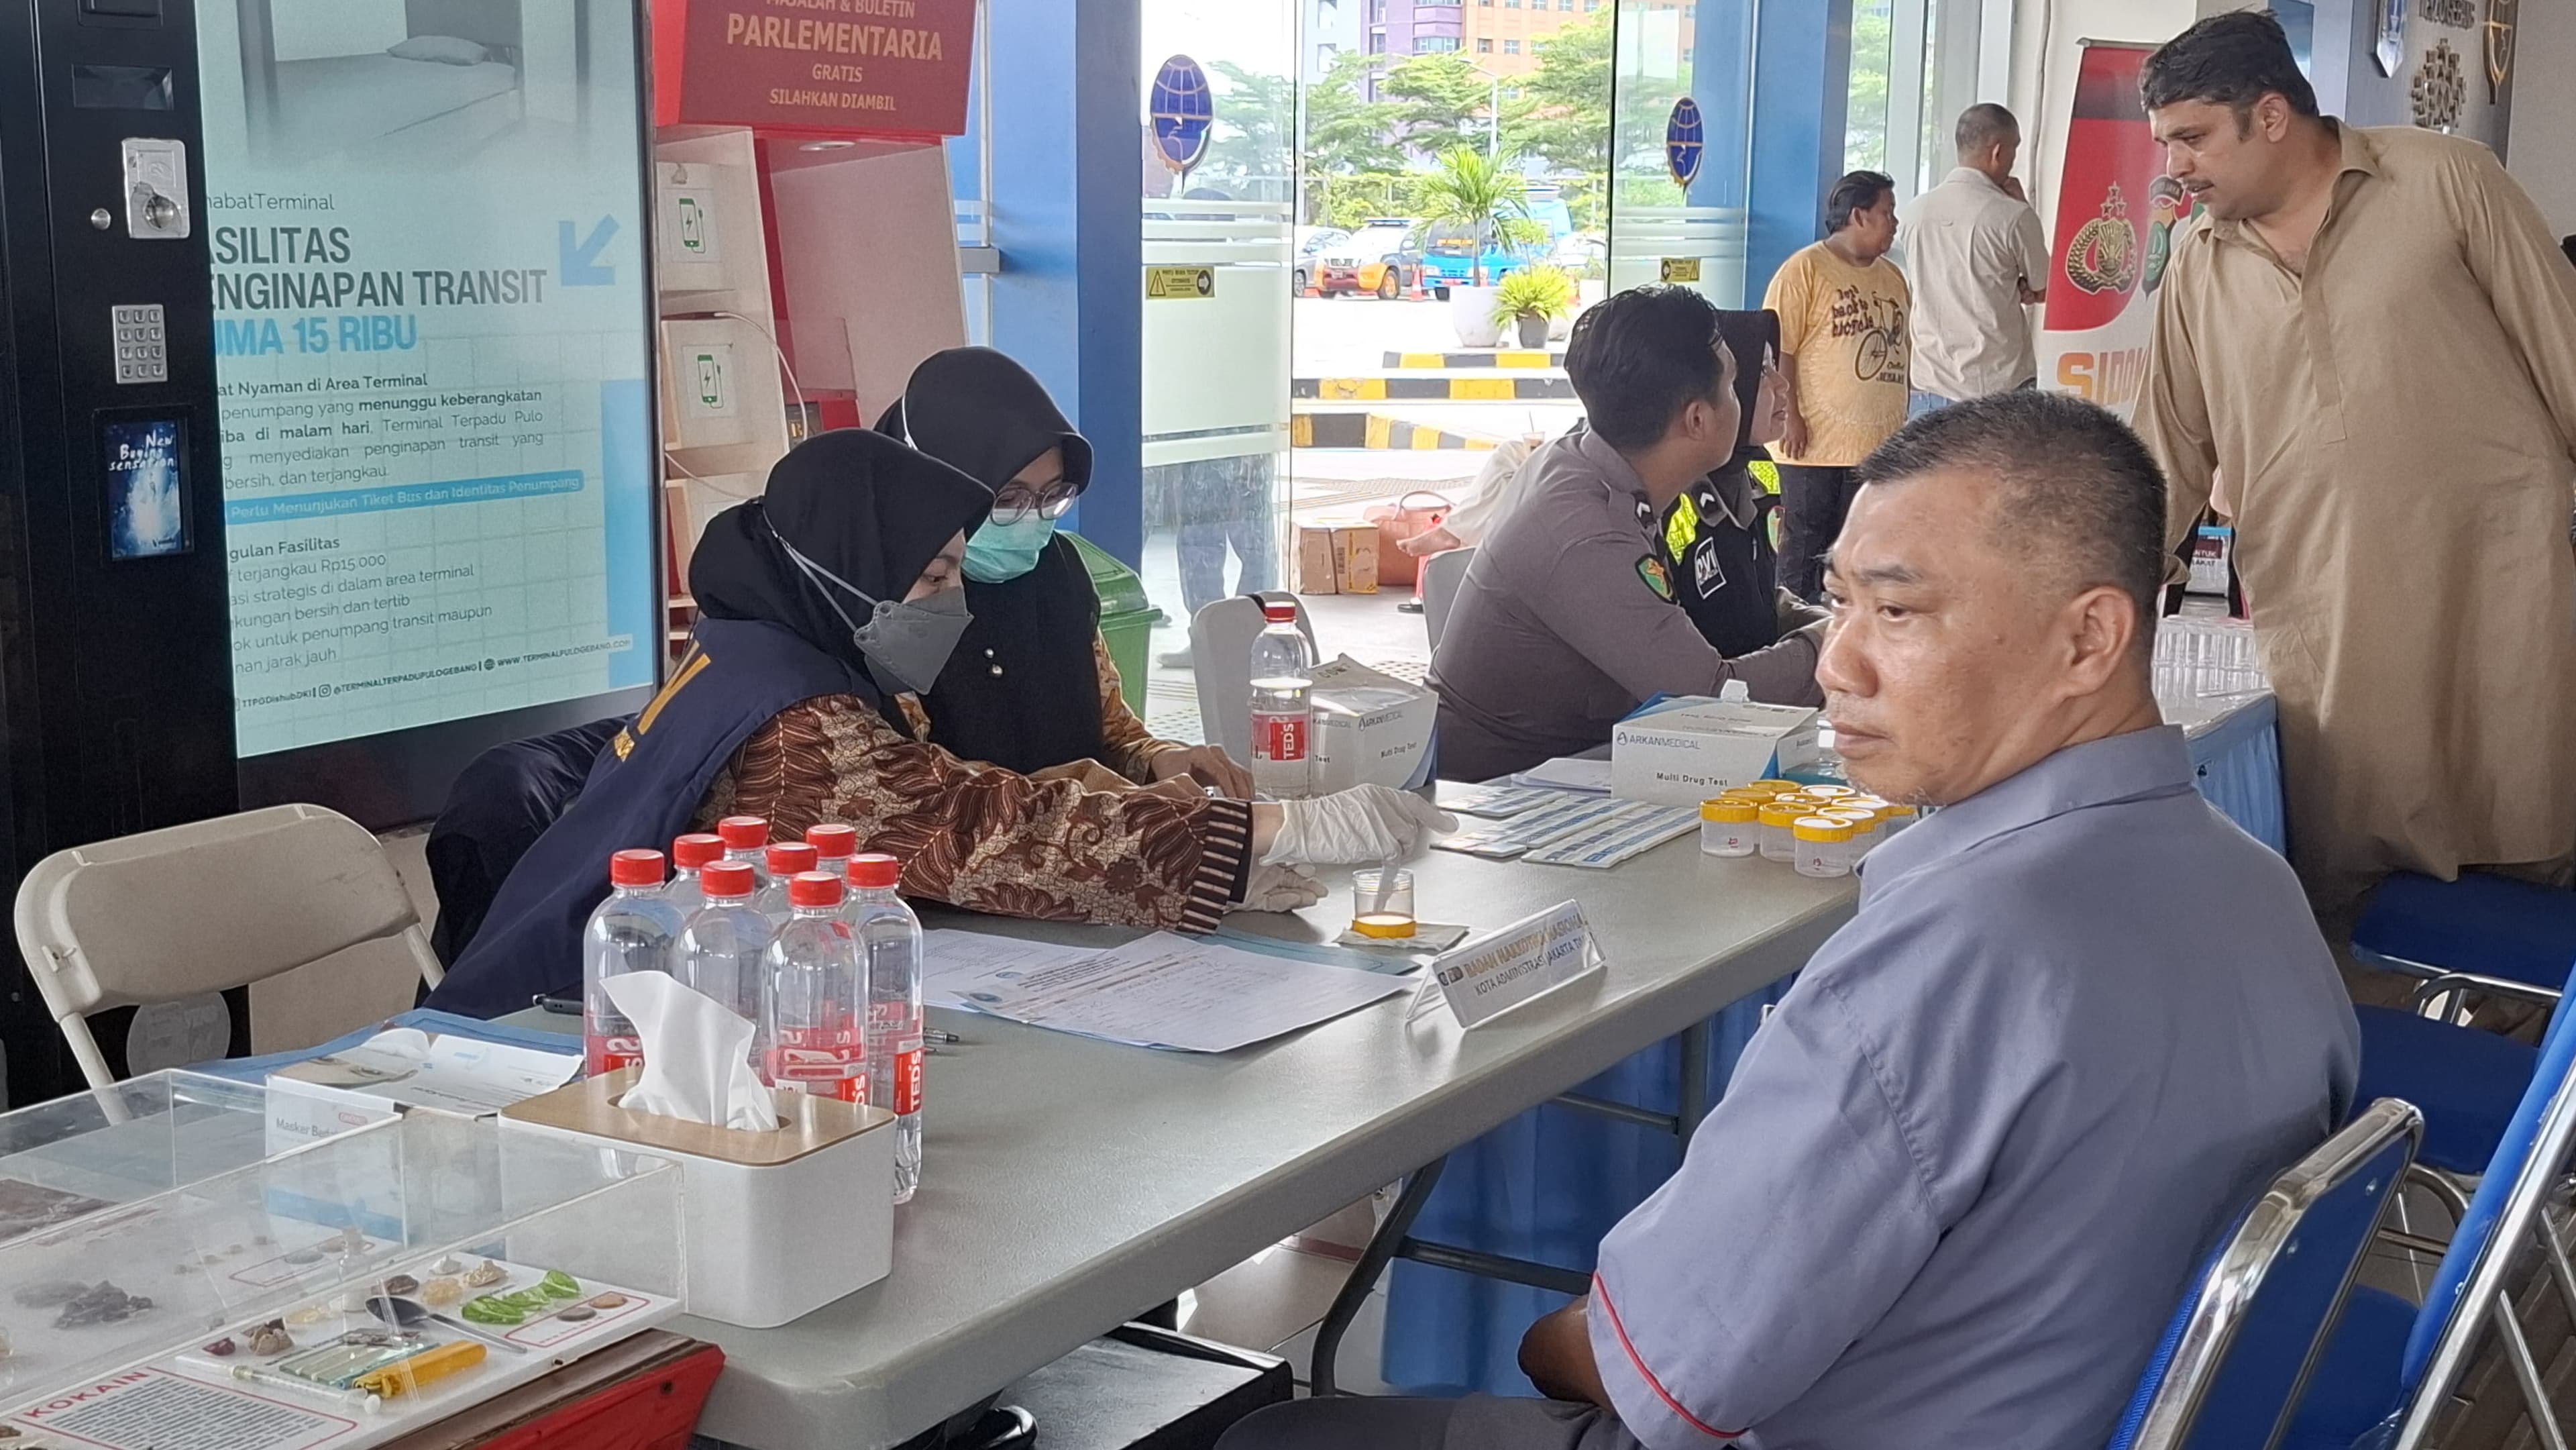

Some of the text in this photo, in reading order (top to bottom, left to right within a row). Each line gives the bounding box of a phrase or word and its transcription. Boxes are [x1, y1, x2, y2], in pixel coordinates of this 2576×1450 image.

[840, 0, 851, 12] &
[855, 0, 915, 18] BULETIN
[727, 13, 943, 60] PARLEMENTARIA
[812, 64, 863, 82] GRATIS
[769, 89, 896, 111] SILAHKAN DIAMBIL
[211, 270, 547, 310] NGINAPAN TRANSIT
[292, 317, 329, 354] 15
[339, 314, 417, 352] RIBU
[238, 382, 303, 398] Nyaman
[307, 378, 321, 391] di
[325, 377, 360, 391] Area
[363, 373, 427, 389] Terminal
[221, 391, 542, 422] penumpang yang menunggu keberangkatan
[256, 427, 269, 440] di
[280, 425, 332, 439] malam
[383, 416, 443, 431] Terminal
[452, 413, 506, 429] Terpadu
[515, 410, 543, 423] Pulo
[250, 446, 349, 464] menyediakan
[364, 439, 445, 458] penginapan
[460, 435, 500, 448] transit
[513, 433, 543, 446] yang
[279, 472, 307, 486] dan
[273, 497, 358, 514] Menunjukan
[363, 493, 394, 507] Tiket
[397, 491, 421, 503] Bus
[425, 488, 449, 501] dan
[451, 482, 506, 498] Identitas
[508, 477, 580, 492] Penumpang
[229, 537, 340, 563] gulan Fasilitas
[237, 563, 317, 582] terjangkau
[254, 584, 317, 603] strategis
[321, 581, 334, 594] di
[338, 576, 382, 592] dalam
[386, 573, 416, 586] area
[420, 564, 474, 582] terminal
[295, 603, 339, 620] bersih
[343, 601, 370, 614] dan
[374, 594, 410, 610] tertib
[256, 631, 297, 648] untuk
[302, 621, 388, 644] penumpang
[393, 612, 435, 629] transit
[439, 605, 492, 623] maupun
[265, 653, 301, 672] jarak
[305, 648, 336, 667] jauh
[1629, 734, 1701, 749] ARKANMEDICAL
[1656, 772, 1727, 786] Multi Drug Test
[1474, 978, 1497, 996] KOTA
[276, 1117, 308, 1135] Masker
[23, 1371, 150, 1418] KOKAIN
